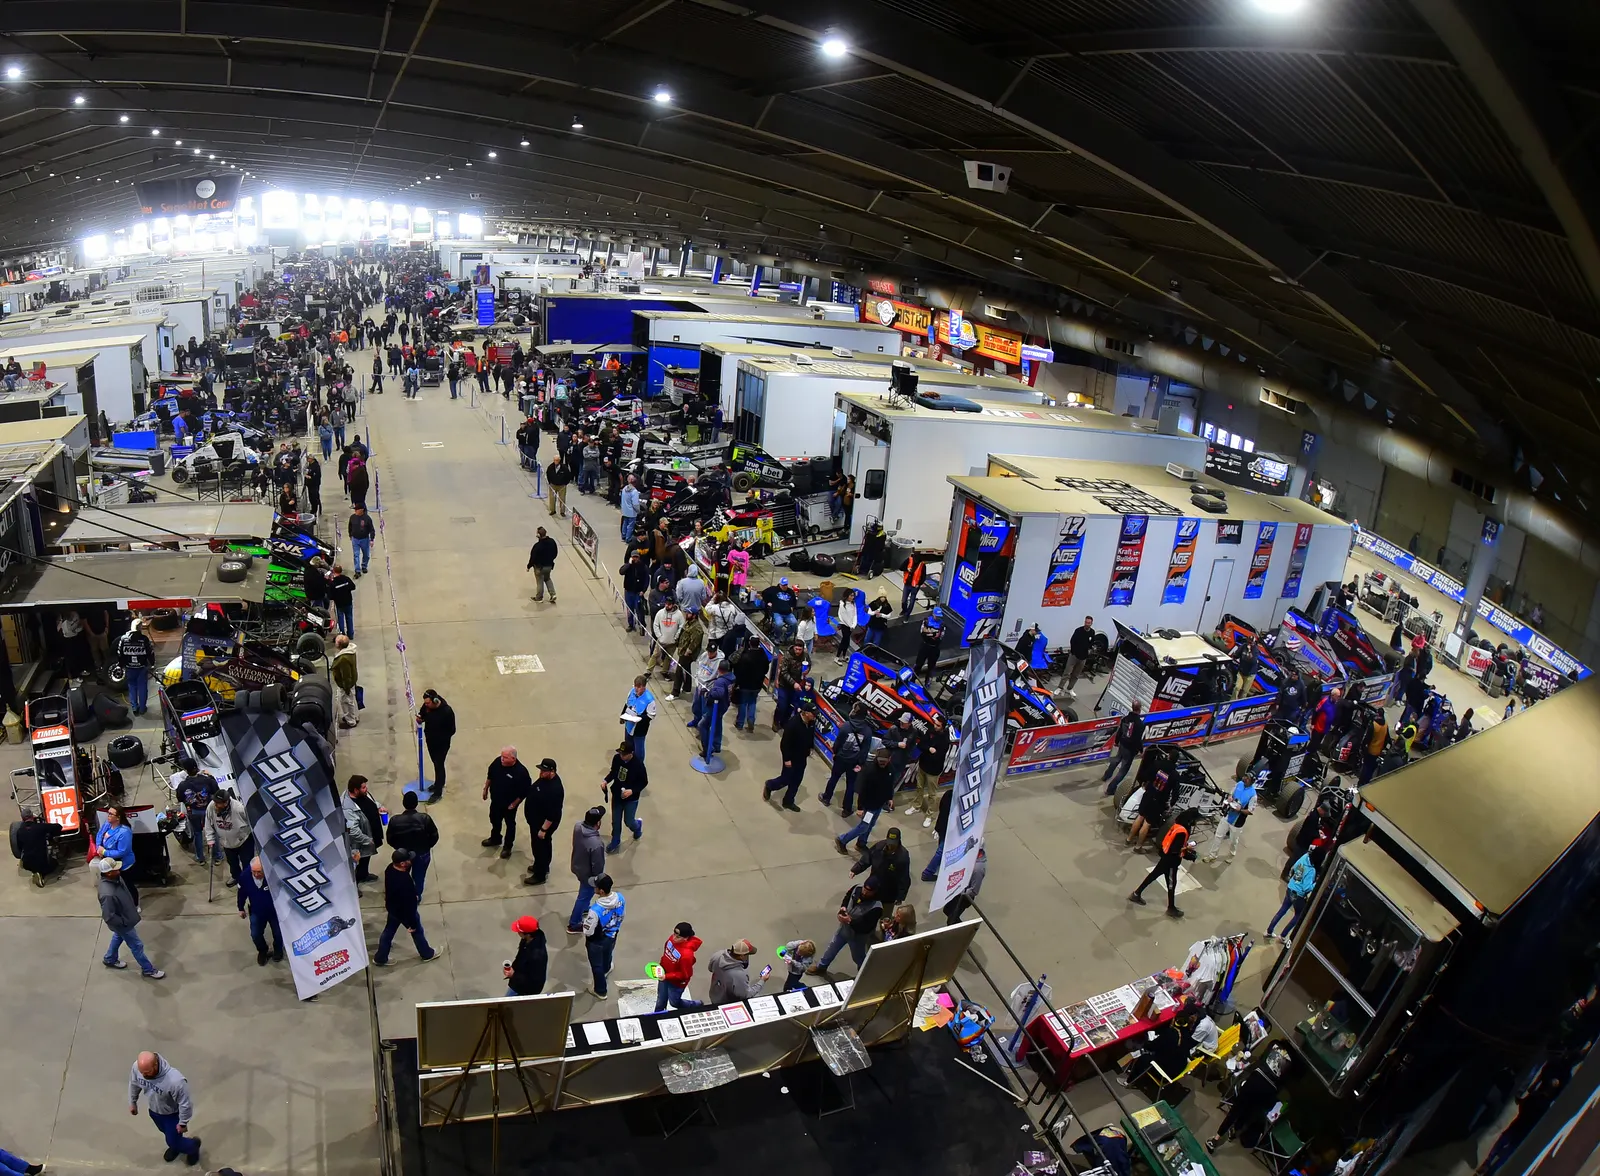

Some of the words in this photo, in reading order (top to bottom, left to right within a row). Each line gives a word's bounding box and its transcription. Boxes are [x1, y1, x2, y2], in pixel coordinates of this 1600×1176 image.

[897, 308, 928, 329] BISTRO
[950, 312, 958, 335] ATM
[1304, 433, 1315, 444] 22
[1303, 443, 1311, 452] N
[744, 466, 762, 475] north
[746, 460, 760, 468] true
[764, 468, 780, 477] .bet
[1060, 516, 1086, 536] 17
[1260, 526, 1275, 540] 87
[1485, 521, 1497, 534] 23
[1299, 527, 1309, 540] 21
[1484, 533, 1493, 542] N
[1053, 548, 1080, 562] NOS
[1373, 545, 1397, 561] DRINK
[1375, 539, 1406, 558] ENERGY
[1171, 552, 1192, 564] NOS
[1253, 555, 1270, 566] NOS
[1410, 560, 1435, 579] NOS
[1431, 578, 1456, 594] DRINK
[1434, 570, 1465, 593] ENERGY
[981, 603, 995, 611] Ford
[1490, 616, 1516, 634] DRINK
[1493, 608, 1524, 631] ENERGY
[204, 637, 227, 645] TOYOTA
[1263, 634, 1277, 646] 21
[1337, 629, 1349, 641] Kraft
[1334, 635, 1351, 651] Builders
[1527, 633, 1555, 661] NOS
[1300, 645, 1331, 673] American
[1554, 649, 1585, 674] ENERGY
[228, 664, 276, 681] CALIFORNIA
[1162, 676, 1193, 697] NOS
[859, 682, 902, 714] NOS
[1251, 704, 1271, 714] ENERGY
[185, 713, 213, 726] BUDDY
[1171, 718, 1196, 728] ENERGY
[1226, 708, 1251, 726] NOS
[1247, 713, 1266, 722] DRINK
[37, 728, 63, 739] TIMMS
[1142, 720, 1171, 740] NOS
[1168, 727, 1191, 737] DRINK
[1018, 731, 1034, 745] 21
[1048, 735, 1088, 750] American
[50, 791, 71, 805] JBL
[49, 806, 76, 828] 67
